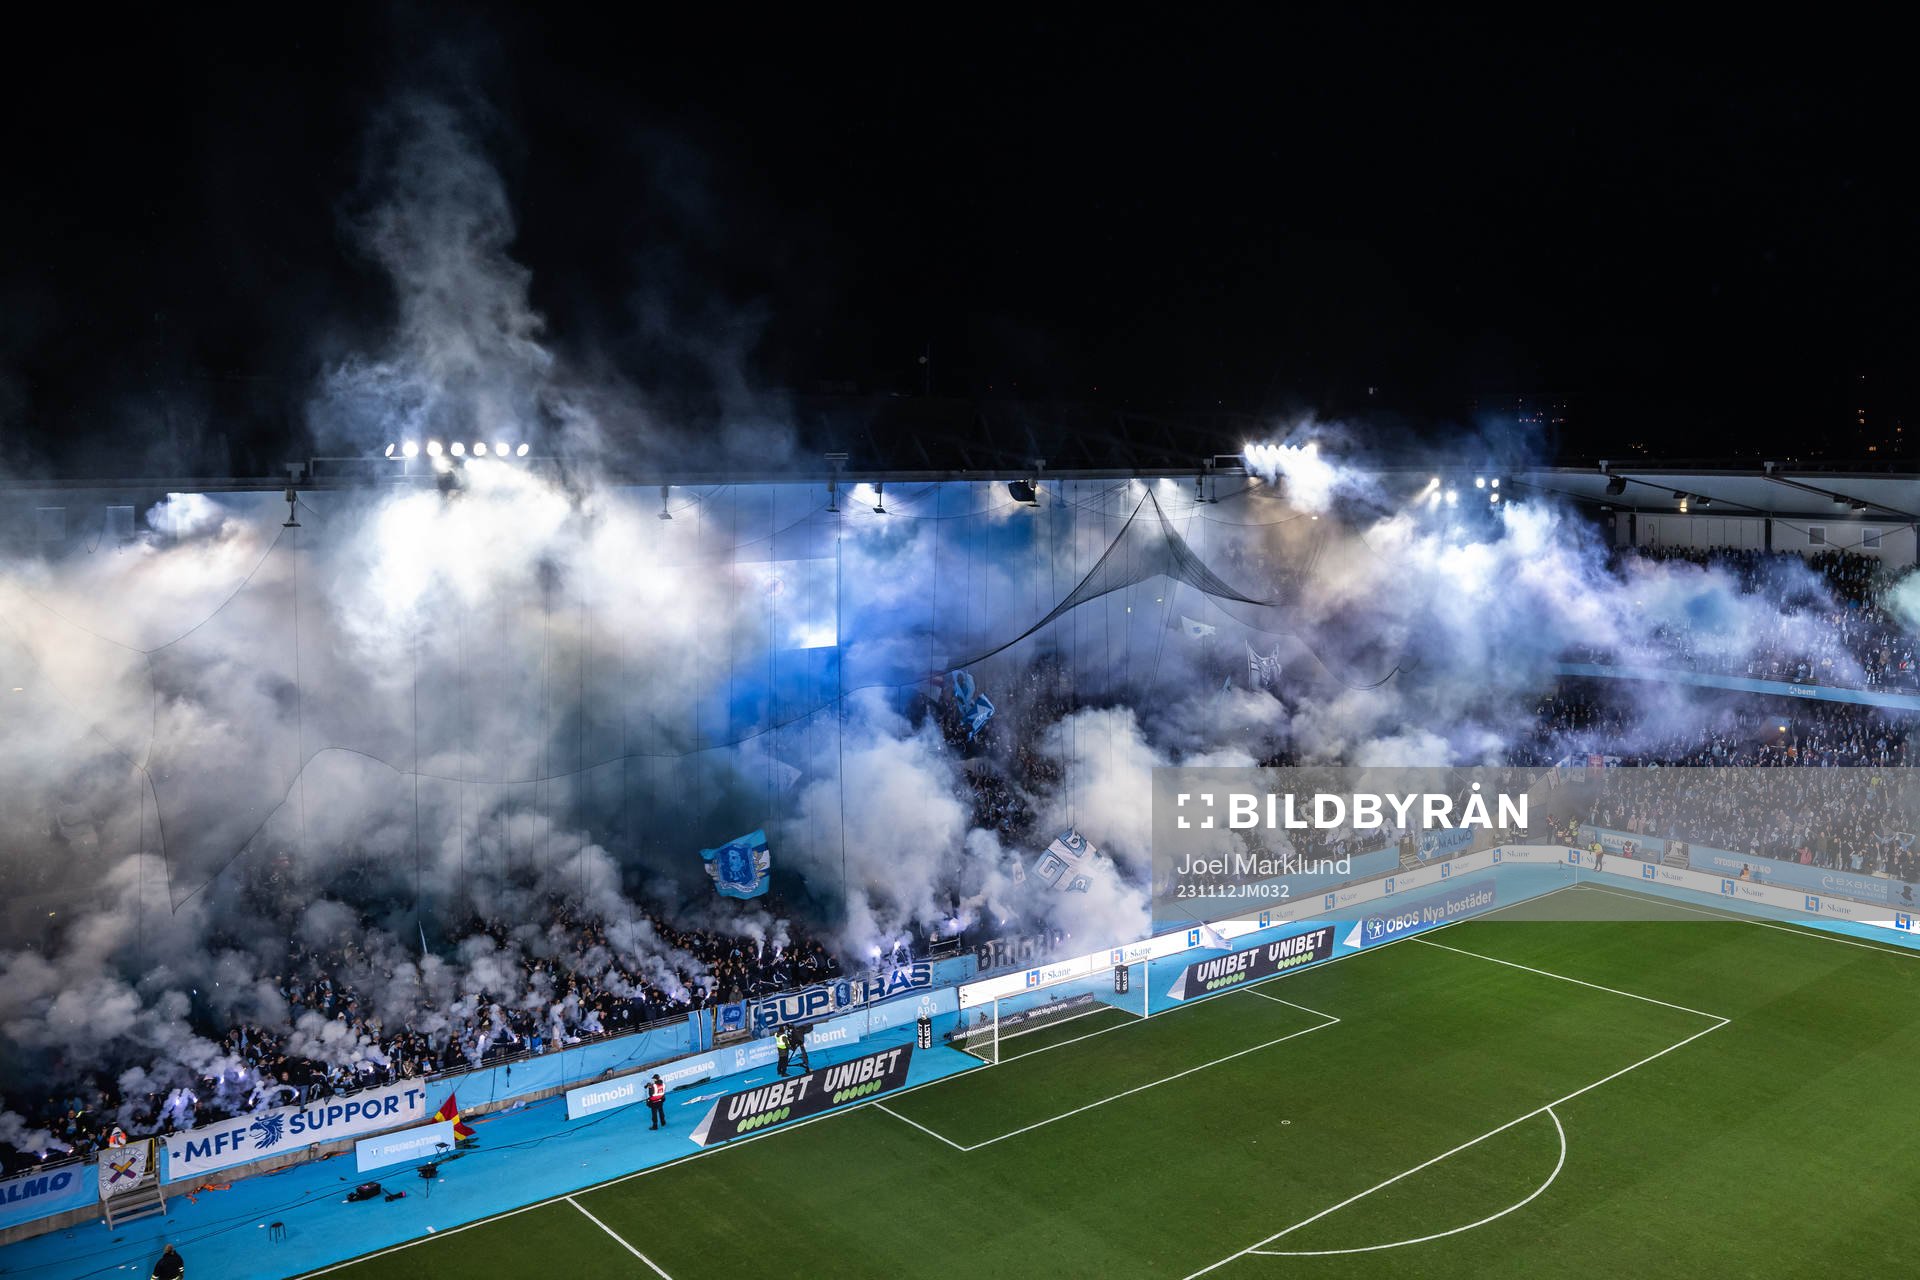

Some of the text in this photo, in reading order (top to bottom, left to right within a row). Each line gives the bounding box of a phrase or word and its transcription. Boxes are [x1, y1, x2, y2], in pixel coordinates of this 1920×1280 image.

[1387, 890, 1493, 933] OBOS Nya bostäder
[1197, 930, 1326, 982] UNIBET UNIBET
[581, 1082, 634, 1108] tillmobil
[728, 1049, 902, 1121] UNIBET UNIBET
[184, 1088, 419, 1163] MFF SUPPORT
